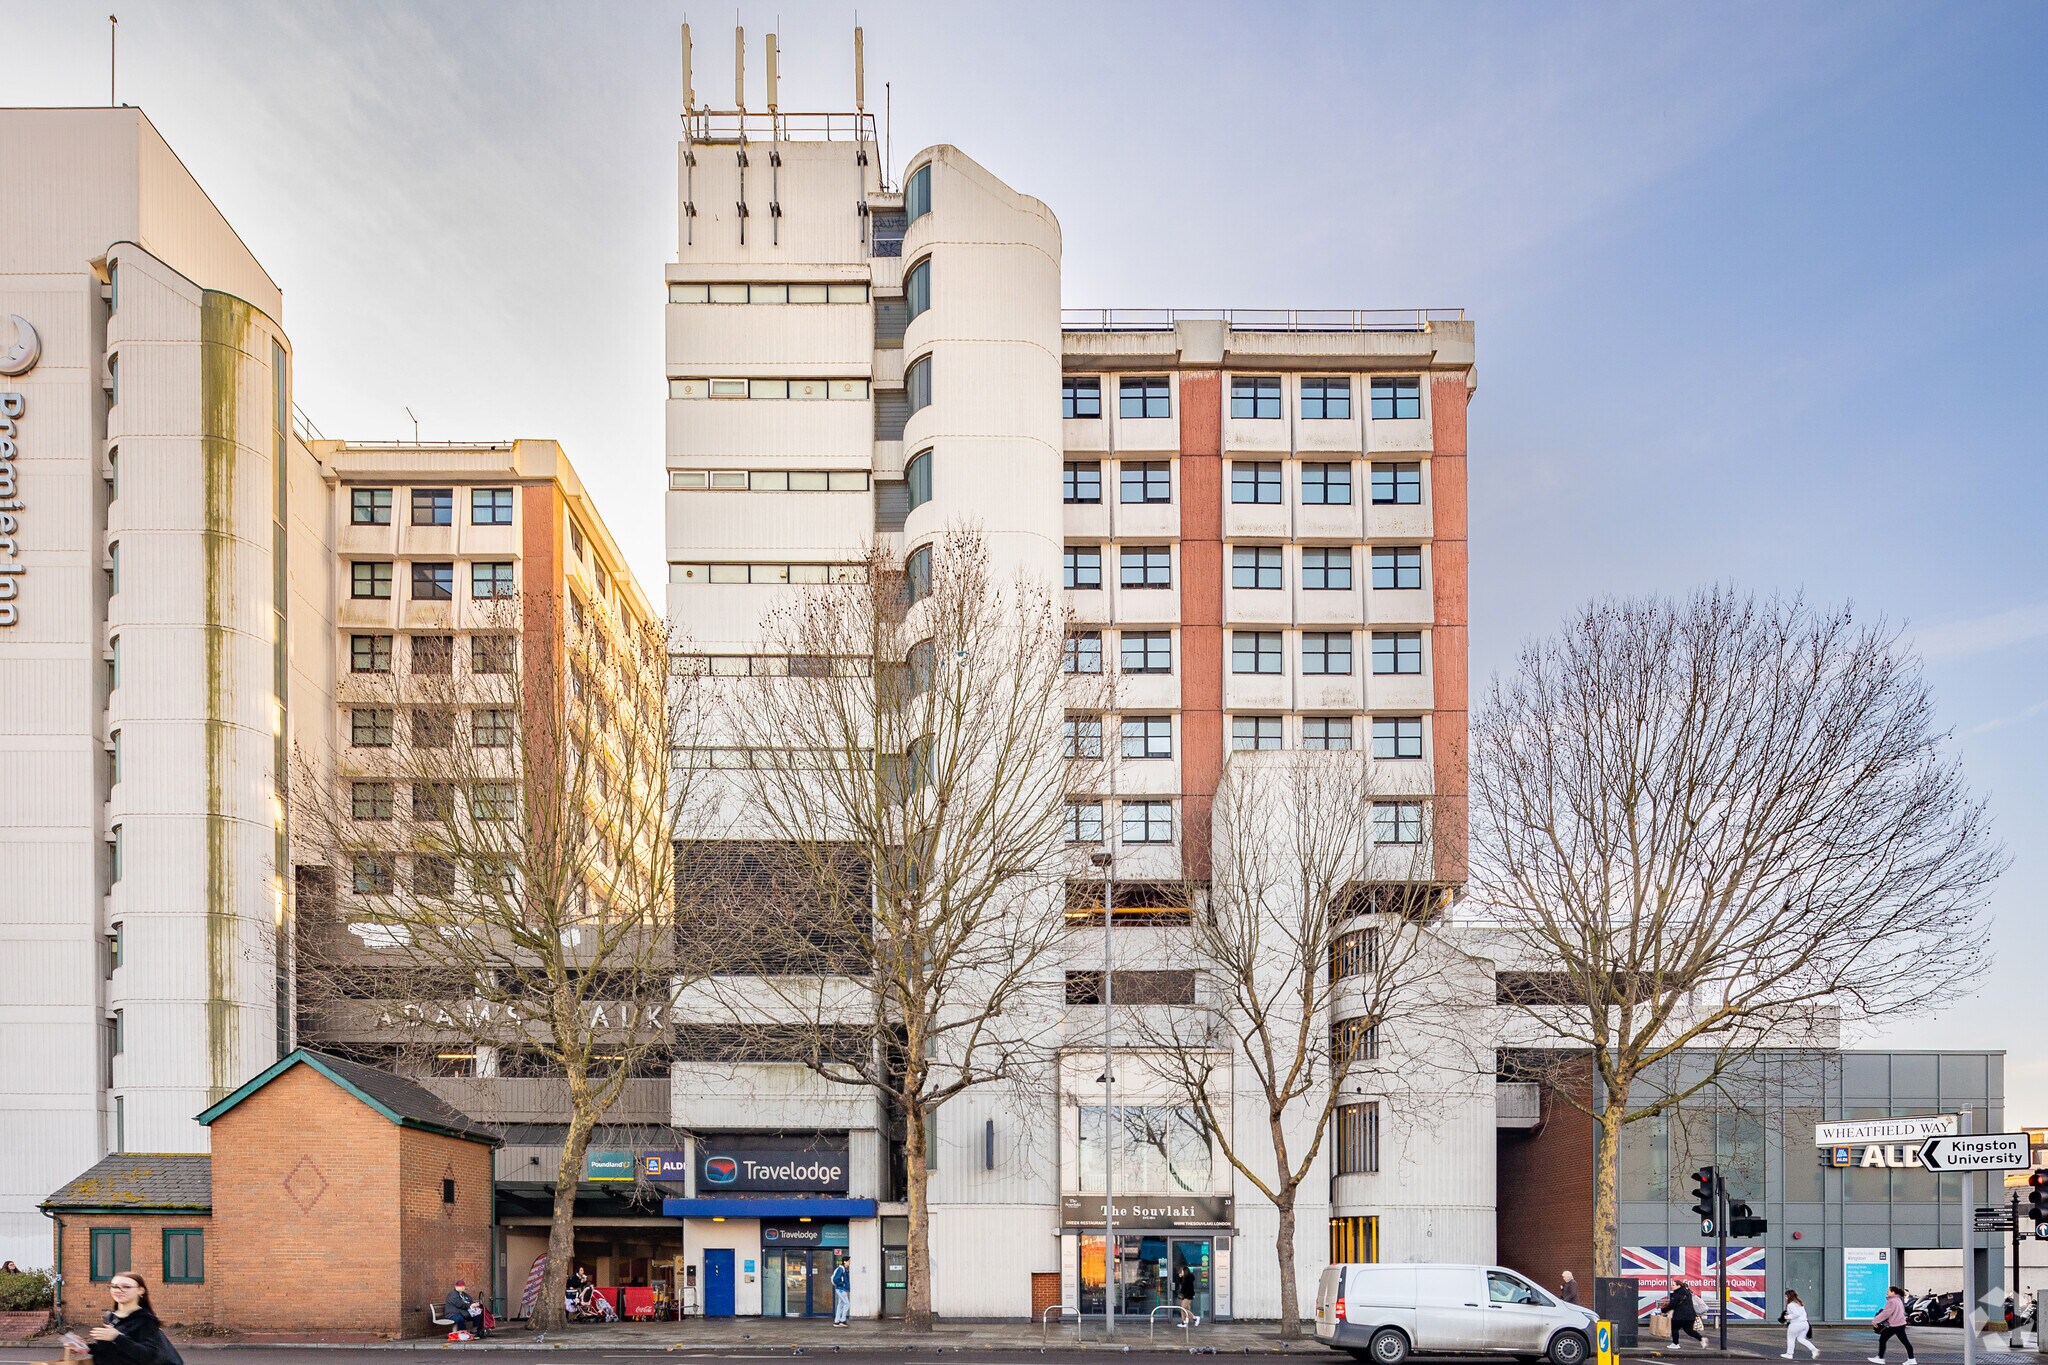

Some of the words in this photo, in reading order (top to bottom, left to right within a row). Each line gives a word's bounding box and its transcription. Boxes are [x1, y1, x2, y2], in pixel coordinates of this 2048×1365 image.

[0, 393, 25, 557] Premier
[0, 563, 26, 626] Inn
[1823, 1125, 1915, 1139] WHEATFIELD
[1920, 1122, 1949, 1134] WAY
[1952, 1140, 2017, 1153] Kingston
[1860, 1144, 1922, 1168] ALD
[1947, 1153, 2023, 1165] University
[743, 1160, 841, 1184] Travelodge
[1100, 1205, 1127, 1216] The
[1133, 1205, 1196, 1217] Souvlaki
[779, 1230, 818, 1240] Travelodge
[1683, 1279, 1702, 1287] Great
[1731, 1278, 1757, 1288] Quality
